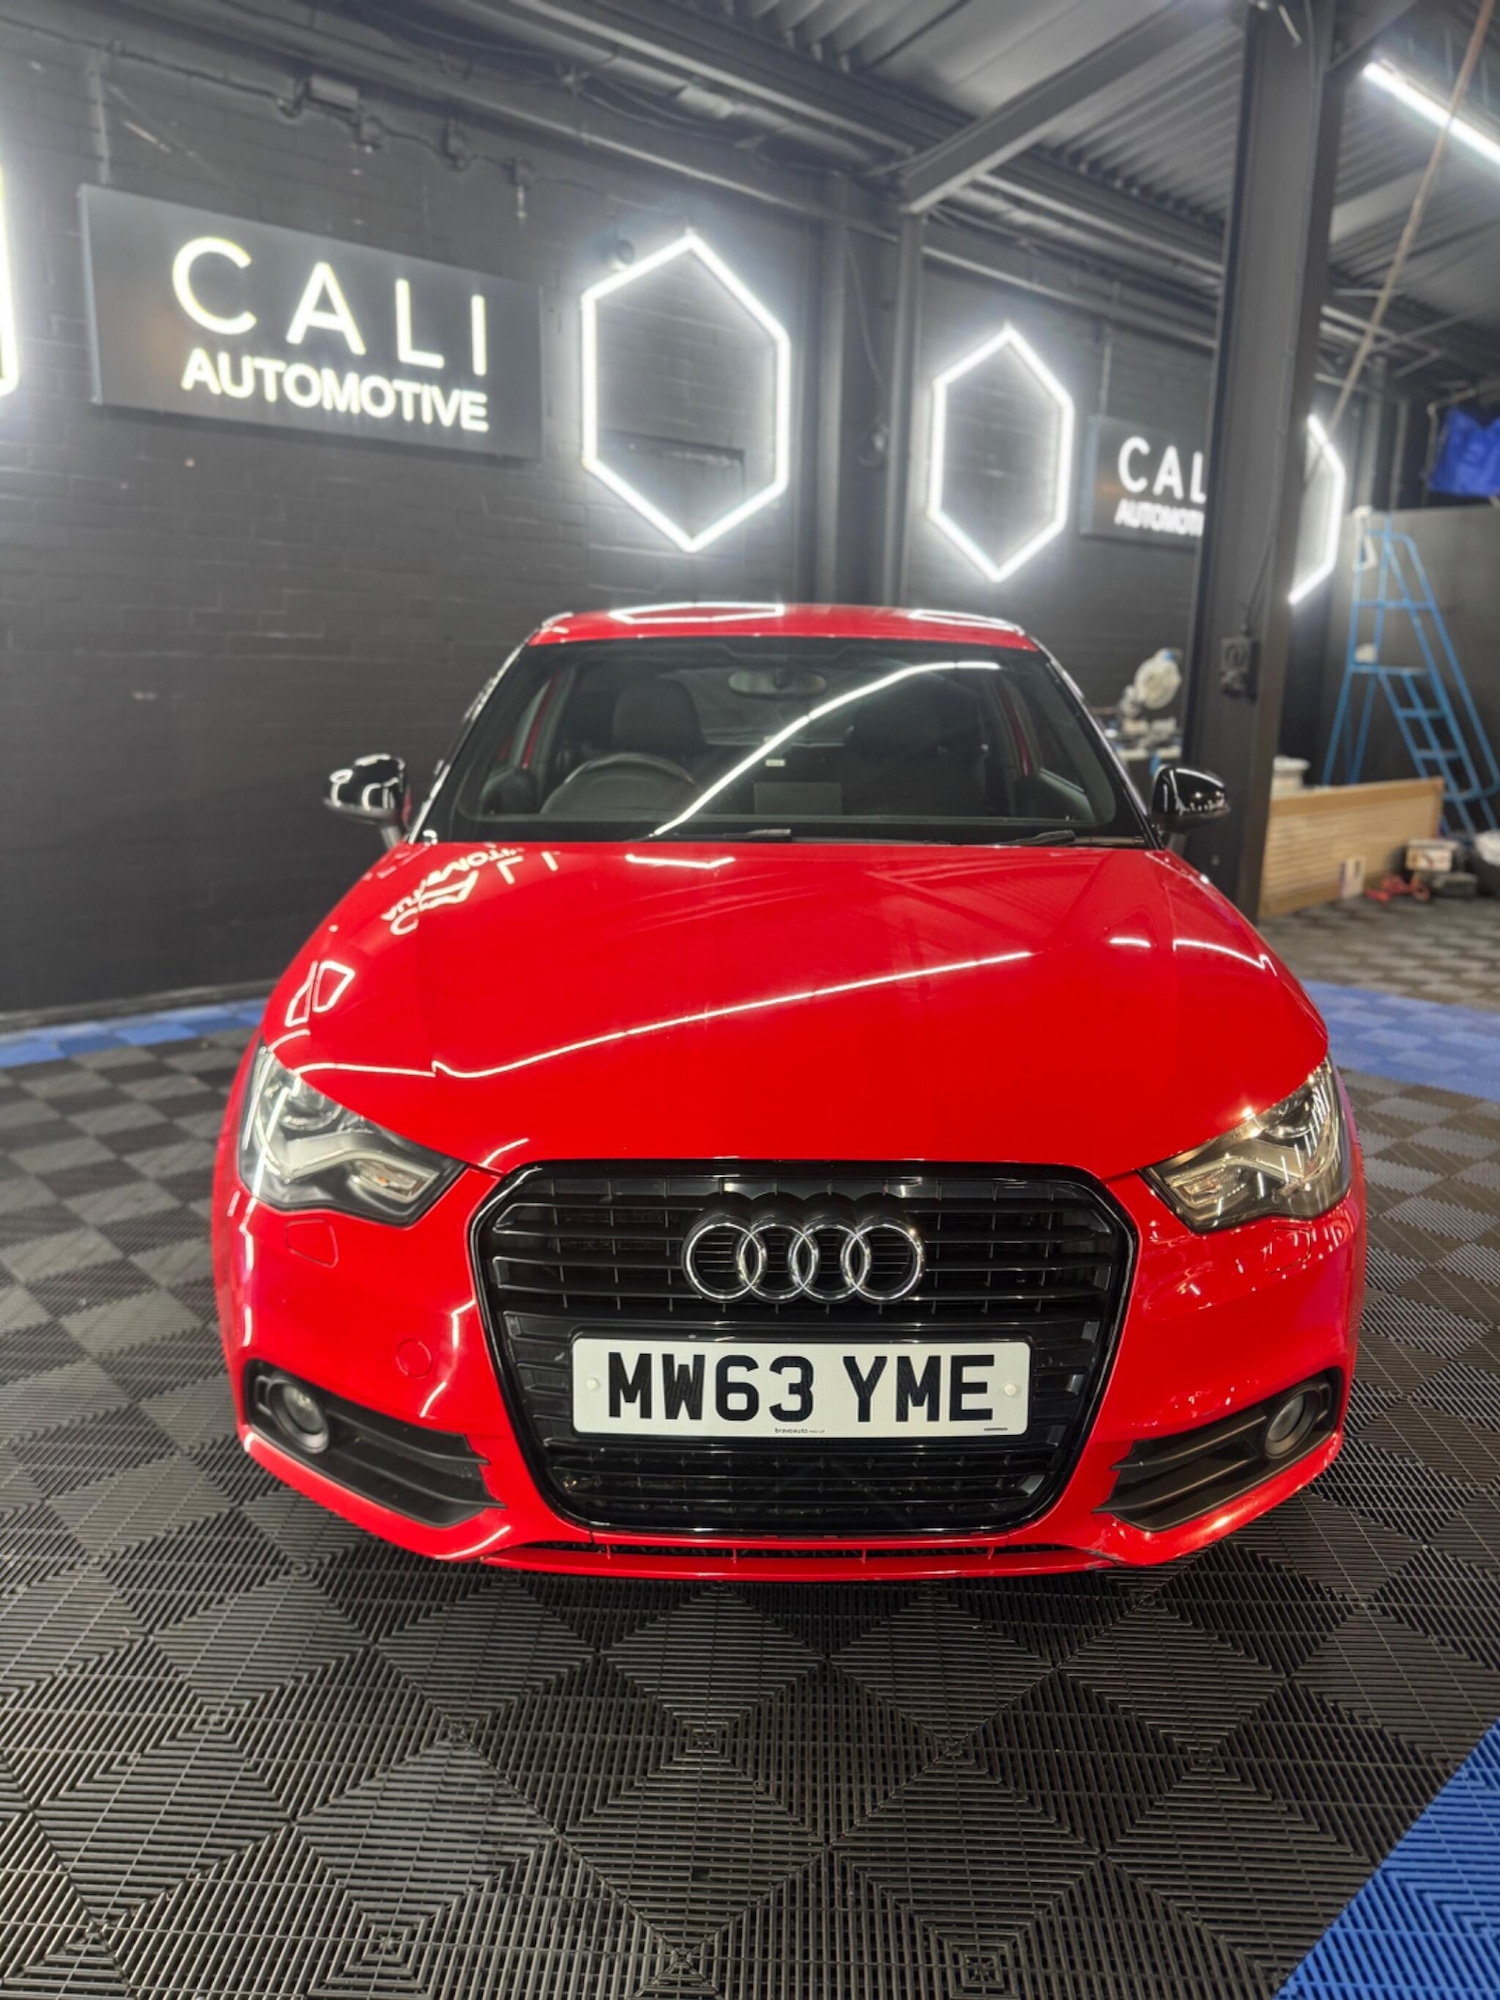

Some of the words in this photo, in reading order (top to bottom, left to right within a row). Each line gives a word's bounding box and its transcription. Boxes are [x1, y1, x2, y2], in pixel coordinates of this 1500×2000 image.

[171, 236, 487, 376] CALI
[180, 346, 489, 433] AUTOMOTIVE
[1117, 436, 1207, 504] CAL
[1114, 497, 1205, 537] AUTOMOTI
[608, 1352, 814, 1423] MW63
[842, 1355, 995, 1422] YME
